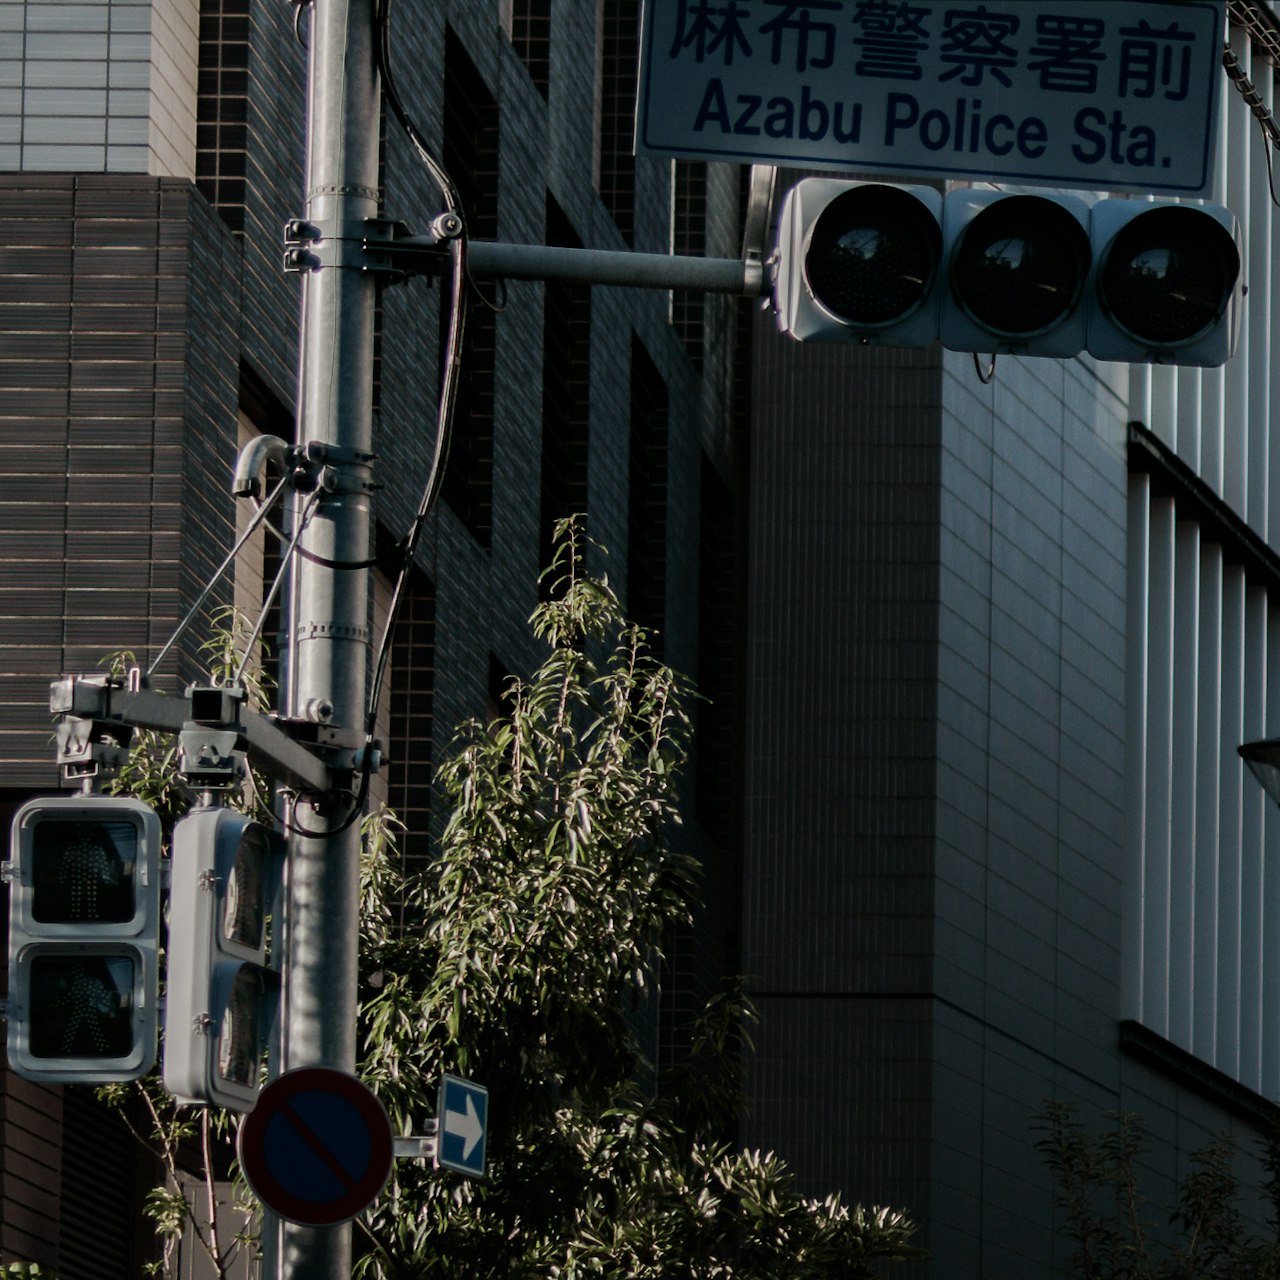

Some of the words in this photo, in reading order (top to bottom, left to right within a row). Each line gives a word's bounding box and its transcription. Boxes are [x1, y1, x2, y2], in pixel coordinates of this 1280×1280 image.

[668, 0, 1197, 102] 麻布警察署前
[693, 77, 862, 144] Azabu
[884, 92, 1047, 159] Police
[1072, 107, 1173, 169] Sta.
